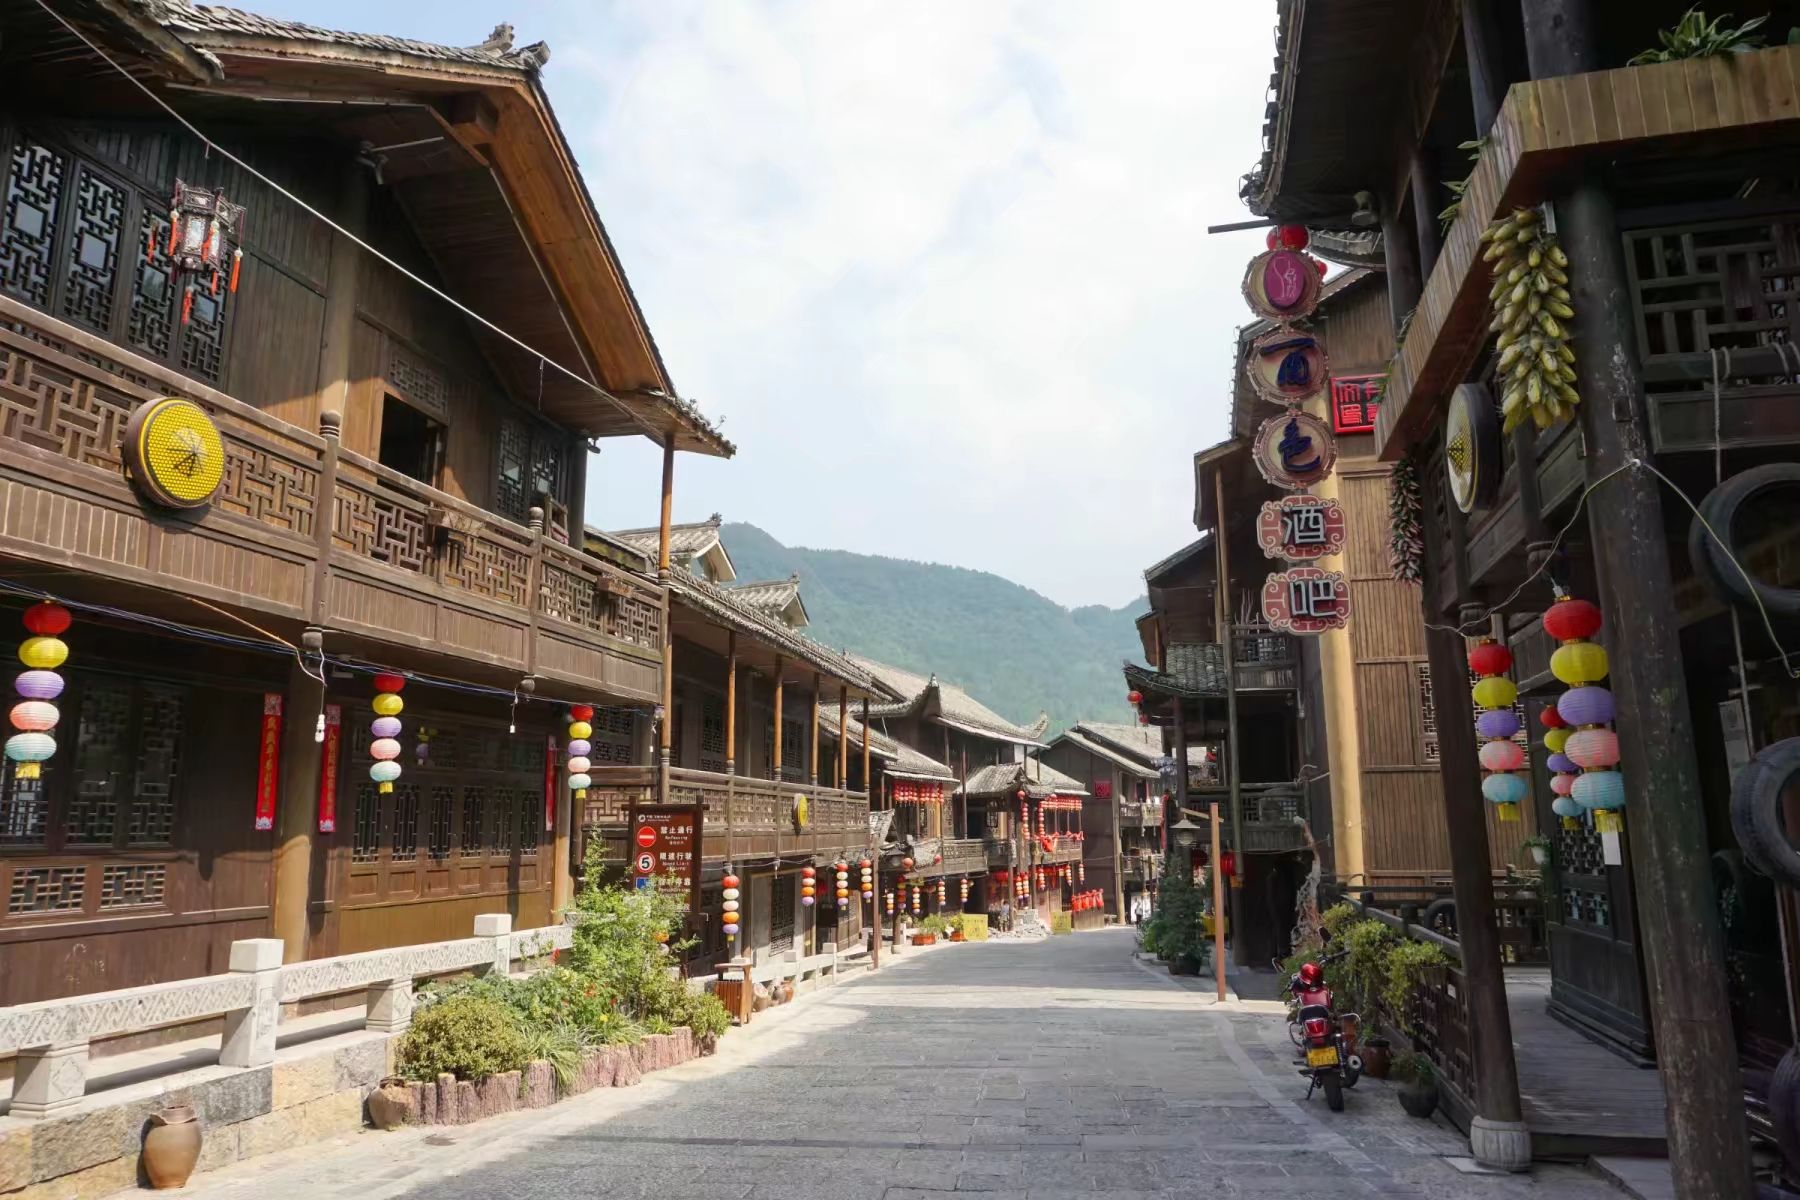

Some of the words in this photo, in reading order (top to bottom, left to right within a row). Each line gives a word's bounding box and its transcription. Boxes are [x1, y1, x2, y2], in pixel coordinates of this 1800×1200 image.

[661, 826, 693, 834] 禁止通行
[660, 852, 692, 860] 限速行驶
[641, 857, 649, 868] 5
